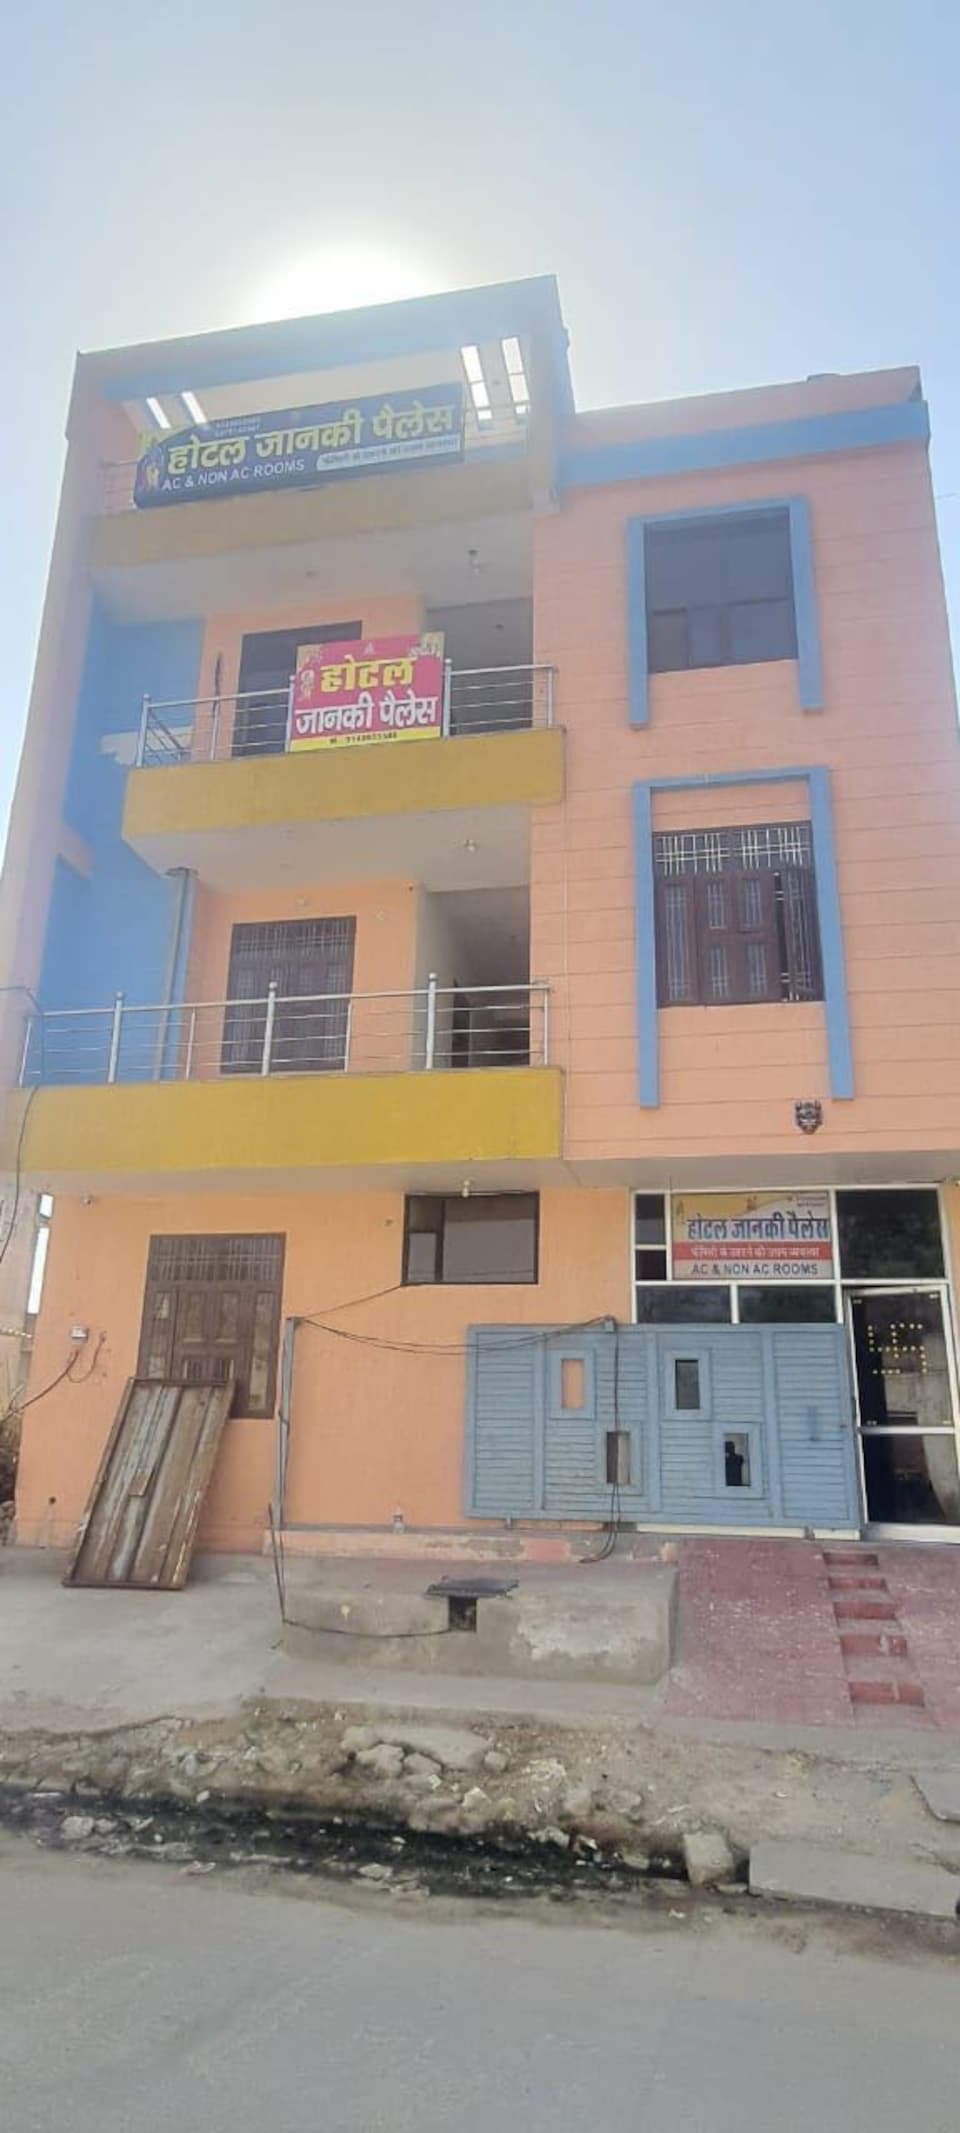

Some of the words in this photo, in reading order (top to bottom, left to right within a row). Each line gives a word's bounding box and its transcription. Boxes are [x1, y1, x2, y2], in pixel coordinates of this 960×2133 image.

[168, 434, 250, 474] होटल
[254, 408, 364, 458] जानकी
[372, 400, 455, 441] पैलेस
[161, 478, 181, 491] AC
[184, 474, 194, 488] &
[199, 470, 228, 485] NON
[231, 466, 249, 480] AC
[253, 458, 305, 477] ROOMS
[319, 654, 417, 693] होटल
[294, 691, 374, 734] जानकी
[379, 689, 439, 728] पैलेस
[687, 1212, 727, 1240] होटल
[731, 1211, 784, 1240] जानकी
[786, 1210, 829, 1239] पैलेस
[692, 1264, 709, 1275] AC
[711, 1264, 721, 1275] &
[724, 1264, 750, 1275] NON
[753, 1264, 770, 1275] AC
[773, 1263, 818, 1275] ROOMS
